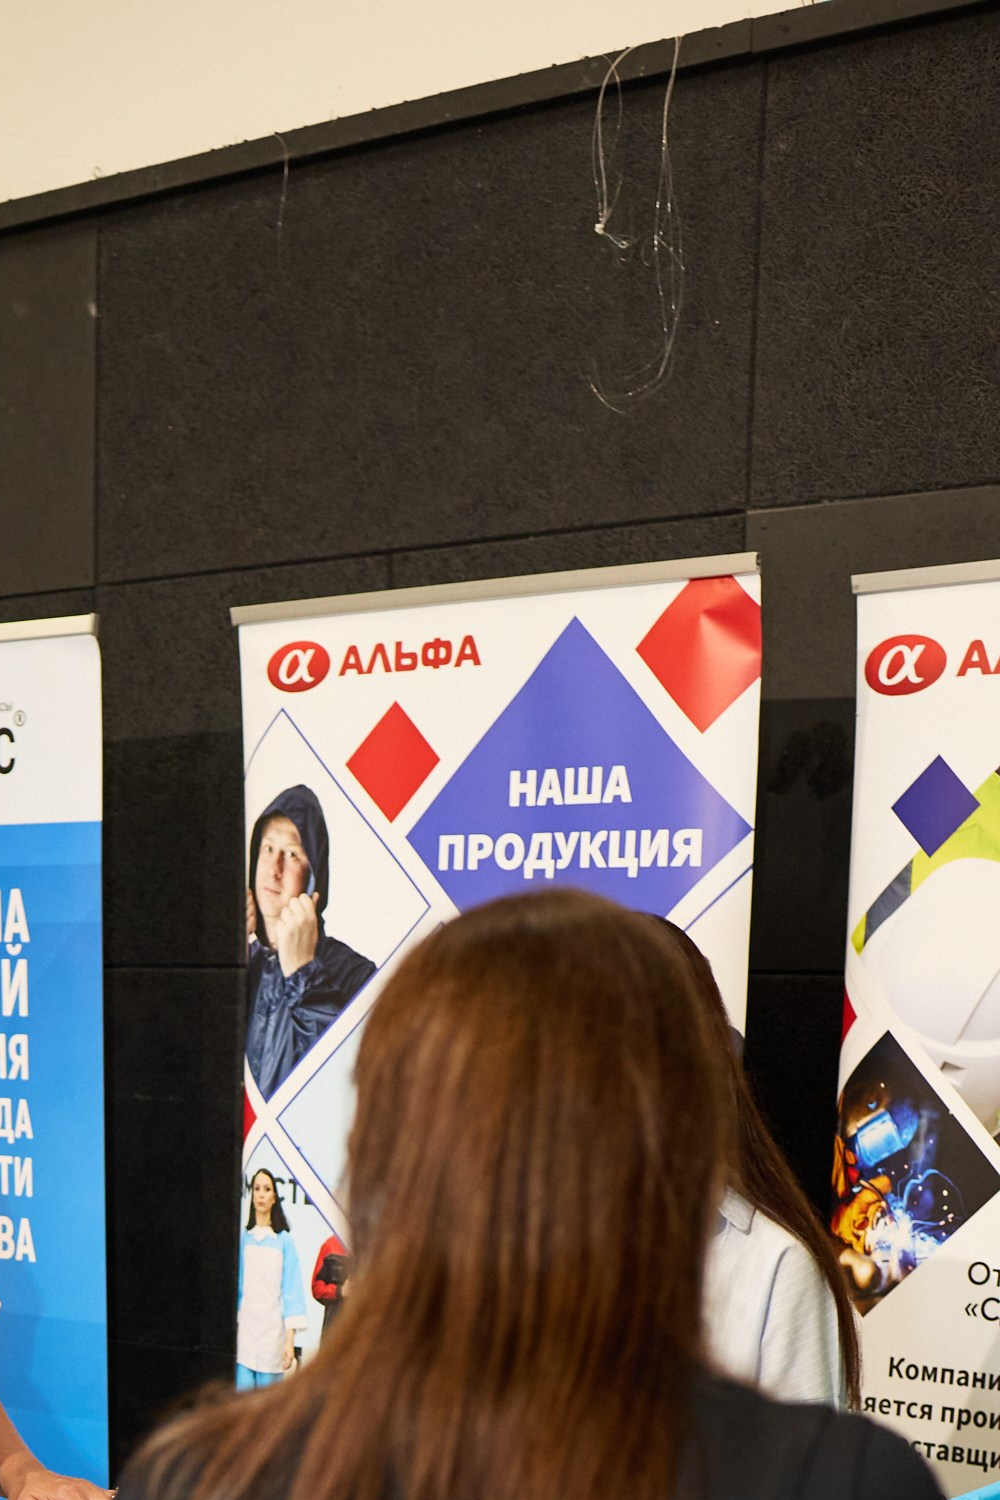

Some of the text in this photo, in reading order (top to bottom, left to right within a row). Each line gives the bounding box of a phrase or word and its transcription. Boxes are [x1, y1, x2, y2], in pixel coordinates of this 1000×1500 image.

[338, 634, 482, 676] АЛЬФА
[956, 639, 1000, 677] А
[508, 765, 633, 807] НАША
[437, 828, 703, 880] ПРОДУКЦИЯ
